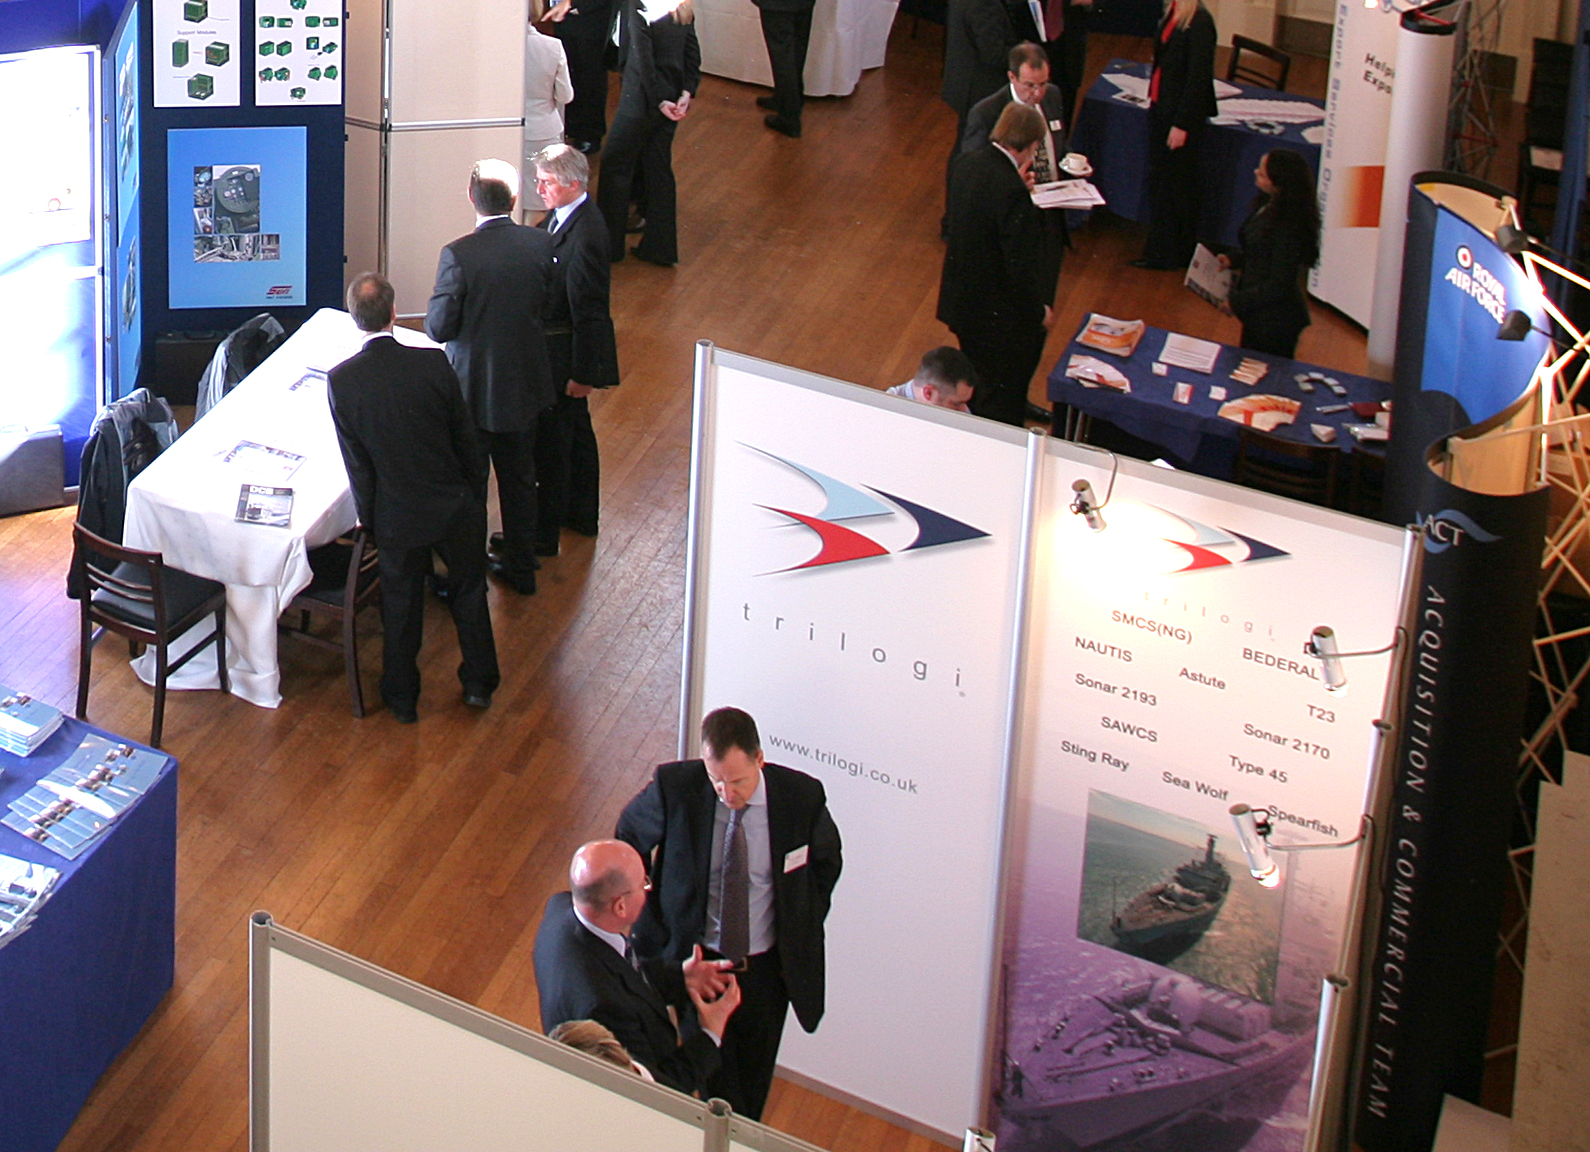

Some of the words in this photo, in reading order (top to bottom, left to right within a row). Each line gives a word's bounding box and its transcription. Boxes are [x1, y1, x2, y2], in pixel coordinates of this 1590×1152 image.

[1363, 70, 1392, 94] Expo
[1364, 53, 1395, 78] Help
[1444, 267, 1471, 294] AIR
[1471, 280, 1506, 324] FORCE
[1472, 261, 1506, 306] ROYAL
[1422, 514, 1467, 547] ACT
[1111, 609, 1193, 646] SMCS(NG)
[1144, 590, 1273, 637] trilogi
[742, 602, 962, 688] trilogi
[1074, 635, 1133, 663] NAUTIS
[1178, 666, 1227, 691] Astute
[1242, 647, 1320, 681] BEDERAL
[1074, 672, 1118, 695] Sonar
[1121, 686, 1158, 707] 2193
[1405, 584, 1446, 794] ACQUISITION
[1100, 716, 1158, 743] SAWCS
[1306, 703, 1336, 724] T23
[1060, 740, 1097, 764] Sting
[1100, 751, 1130, 772] Ray
[1243, 723, 1288, 747] Sonar
[1292, 737, 1331, 760] 2170
[768, 733, 918, 795] www.trilogi.co.uk
[1228, 754, 1265, 777] Type
[1268, 768, 1288, 784] 45
[1161, 771, 1191, 790] Sea
[1195, 780, 1229, 802] Wolf
[1268, 804, 1339, 838] Spearfish
[1401, 804, 1423, 823] &
[1378, 837, 1418, 1026] COMMERCIAL
[1367, 1042, 1395, 1119] TEAM
